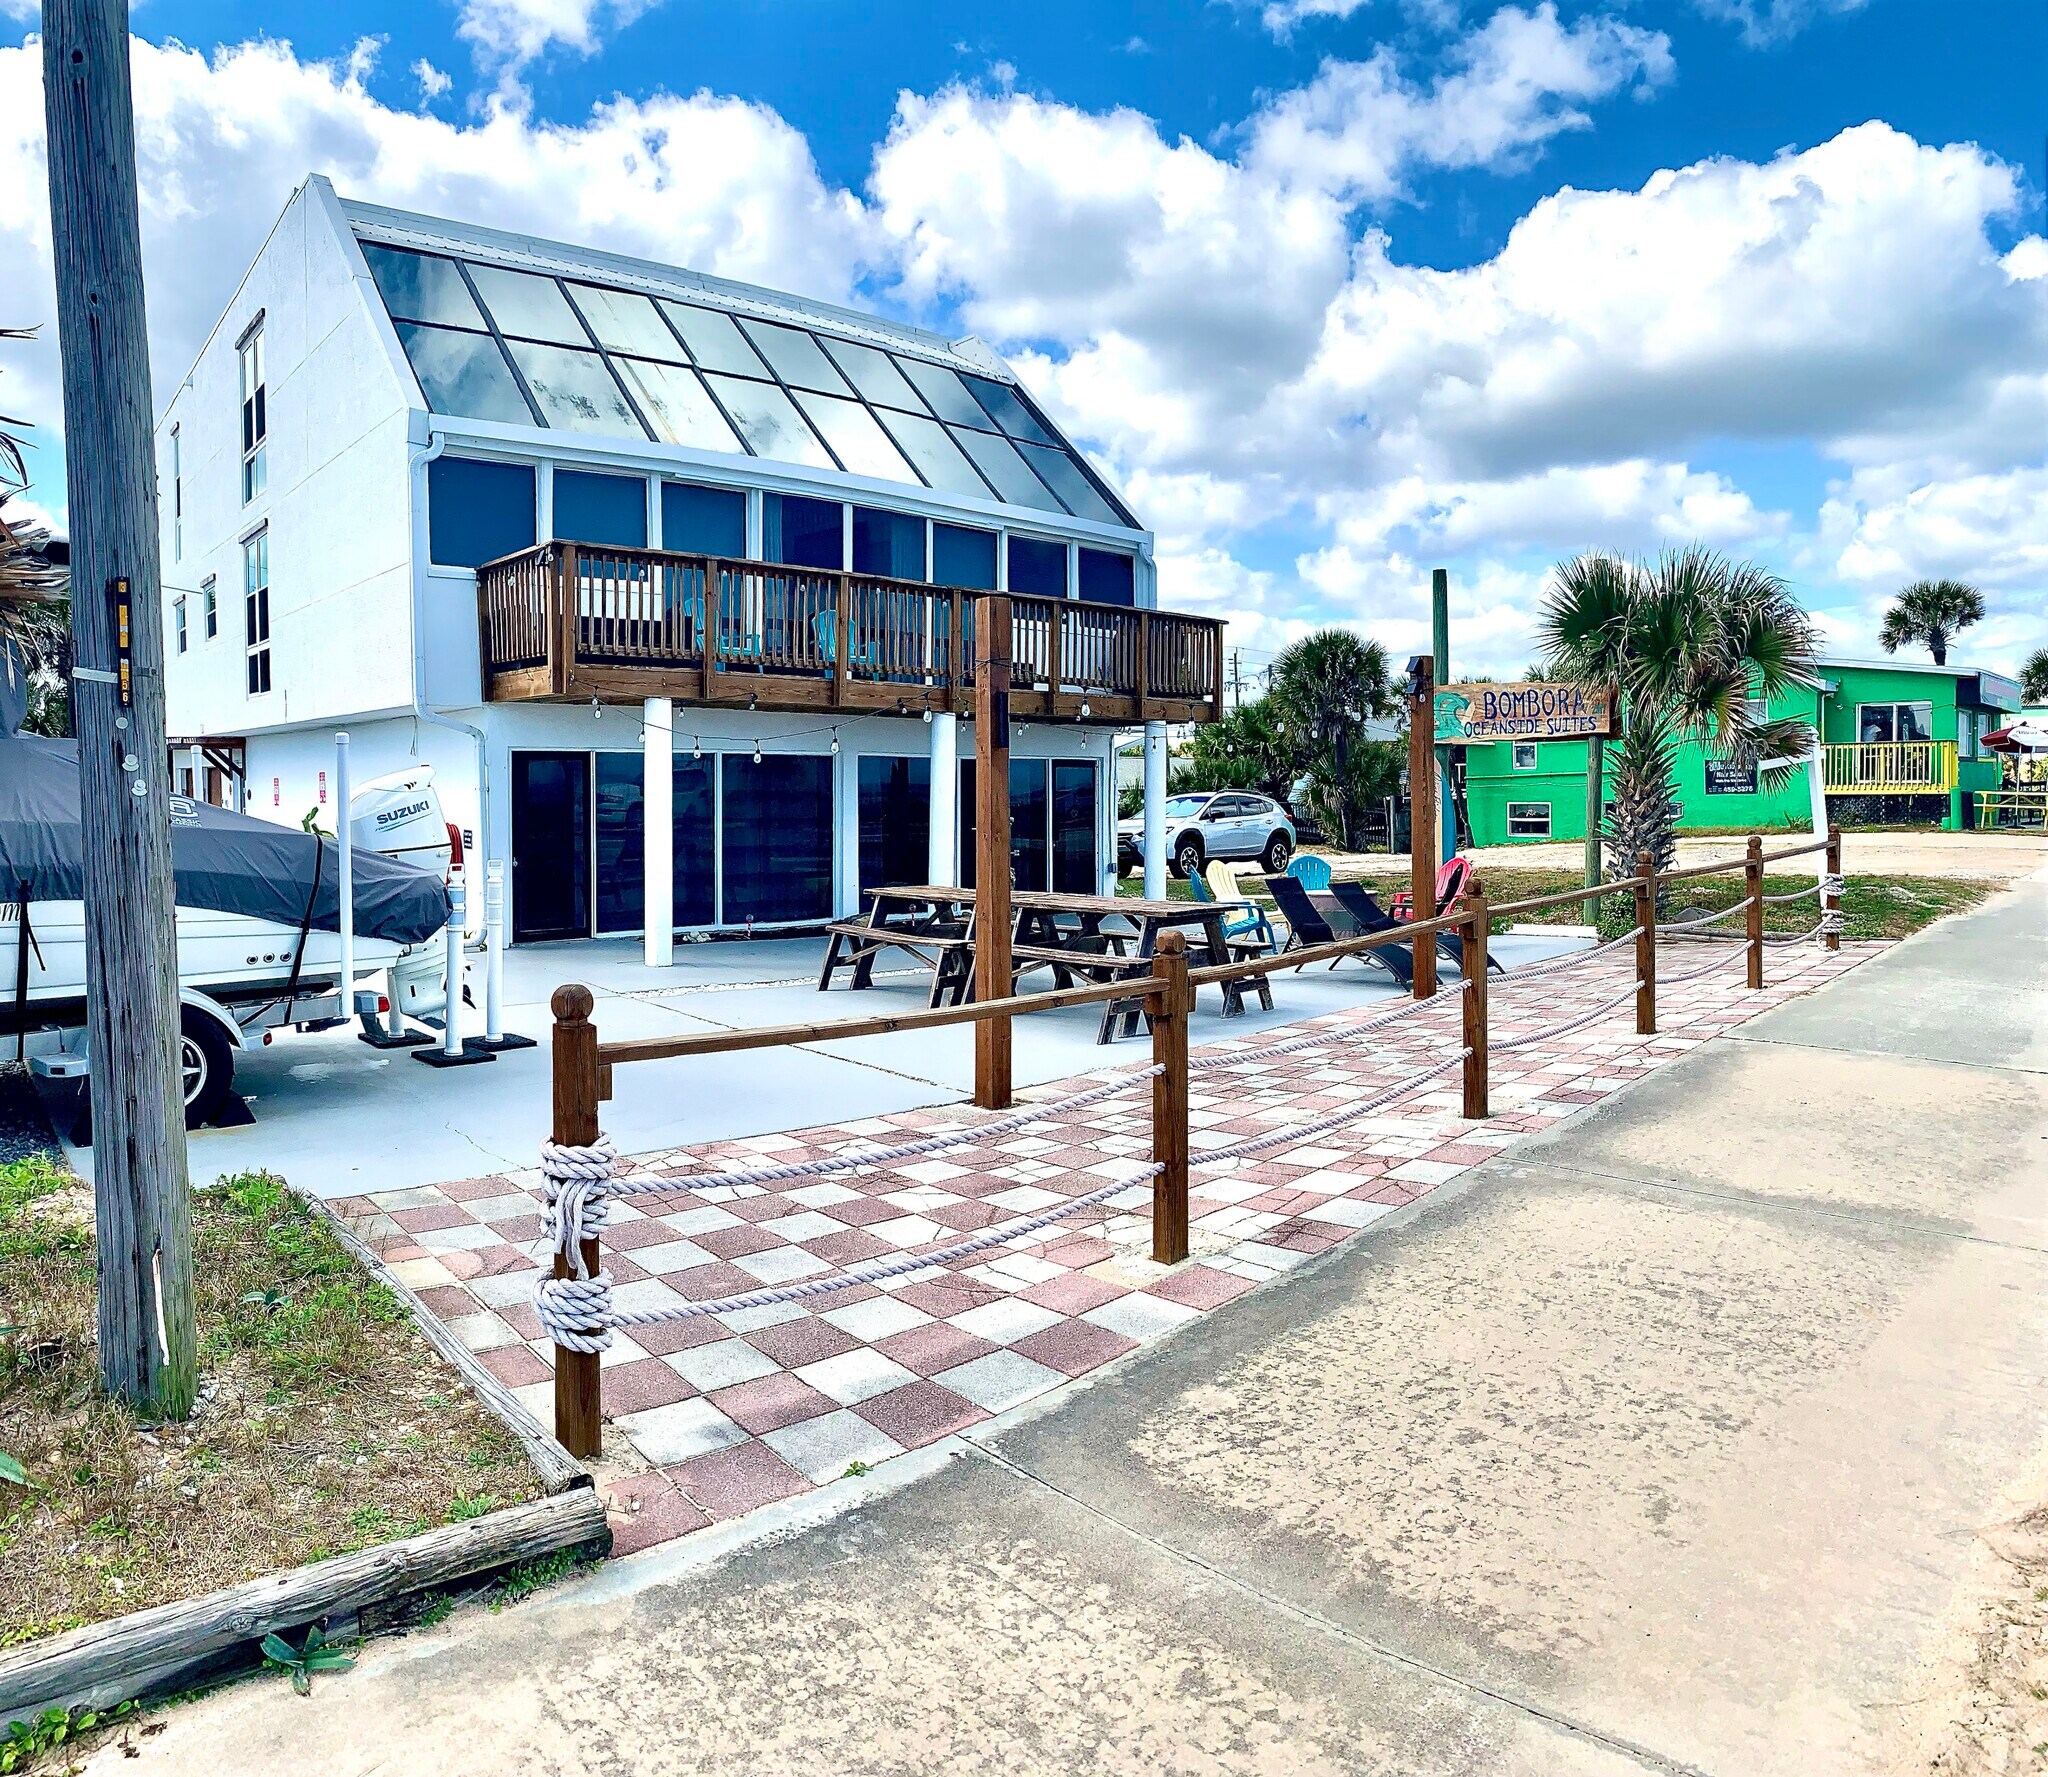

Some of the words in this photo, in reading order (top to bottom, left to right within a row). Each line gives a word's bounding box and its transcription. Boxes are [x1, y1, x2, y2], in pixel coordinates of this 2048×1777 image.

[1483, 688, 1587, 720] BOMBORA
[1463, 718, 1543, 738] OCEANSIDE
[1546, 716, 1598, 736] SUITES
[376, 800, 430, 825] SUZUKI
